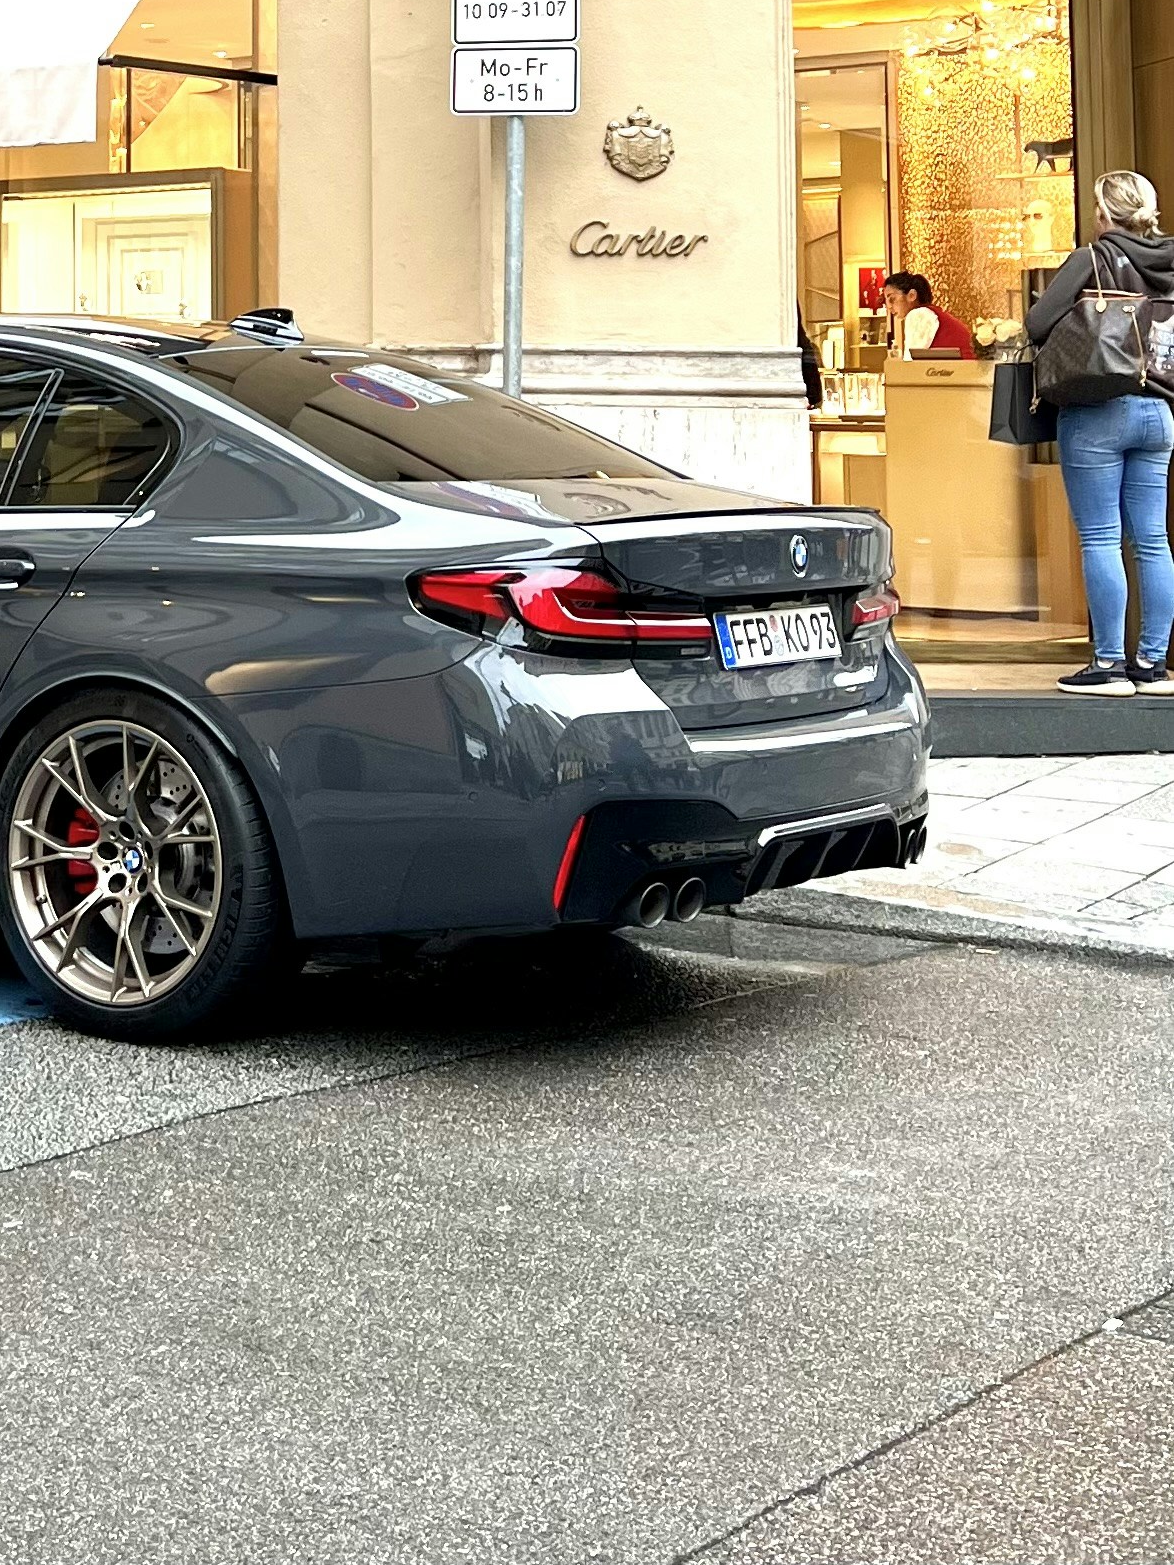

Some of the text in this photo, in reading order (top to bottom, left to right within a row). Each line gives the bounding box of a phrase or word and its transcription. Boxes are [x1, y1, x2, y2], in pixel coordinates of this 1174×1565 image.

[480, 57, 548, 77] Mo-Fr
[483, 83, 543, 102] 8-15 h
[569, 220, 709, 258] Cartier
[729, 617, 774, 660] FFB
